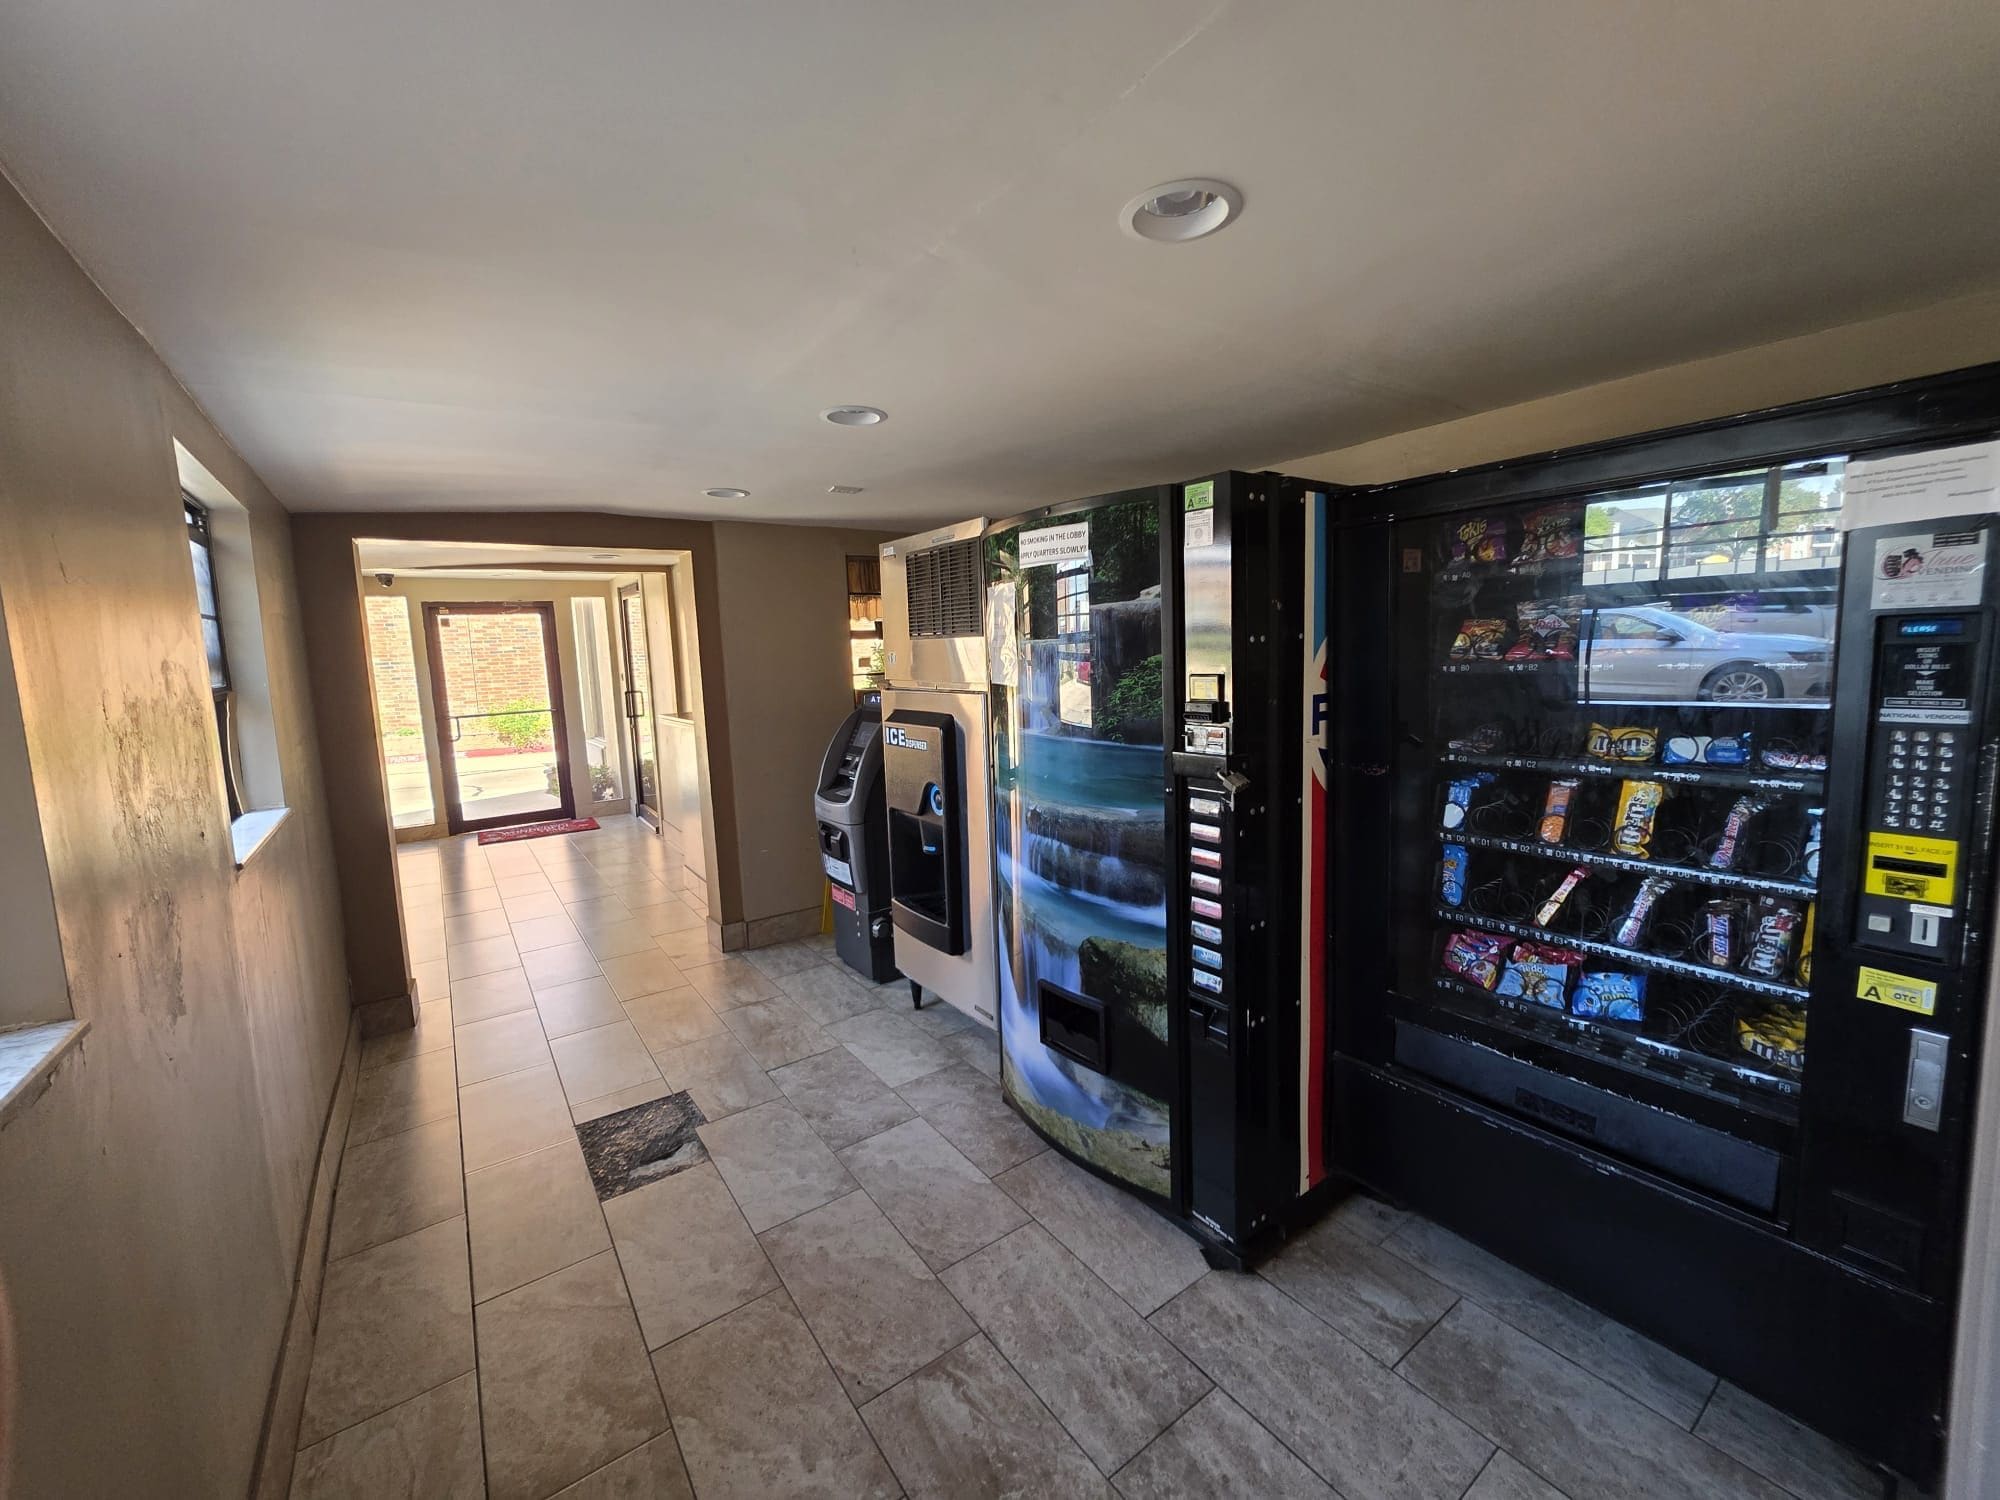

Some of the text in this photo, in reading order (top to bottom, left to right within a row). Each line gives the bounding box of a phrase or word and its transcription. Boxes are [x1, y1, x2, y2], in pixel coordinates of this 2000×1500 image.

[1027, 535, 1048, 545] SMOKING
[1049, 533, 1055, 541] IN
[1055, 532, 1066, 540] THE
[1066, 530, 1086, 539] LOBBY
[1033, 548, 1059, 558] QUARTERS
[885, 727, 906, 746] ICE
[1864, 986, 1881, 1000] A
